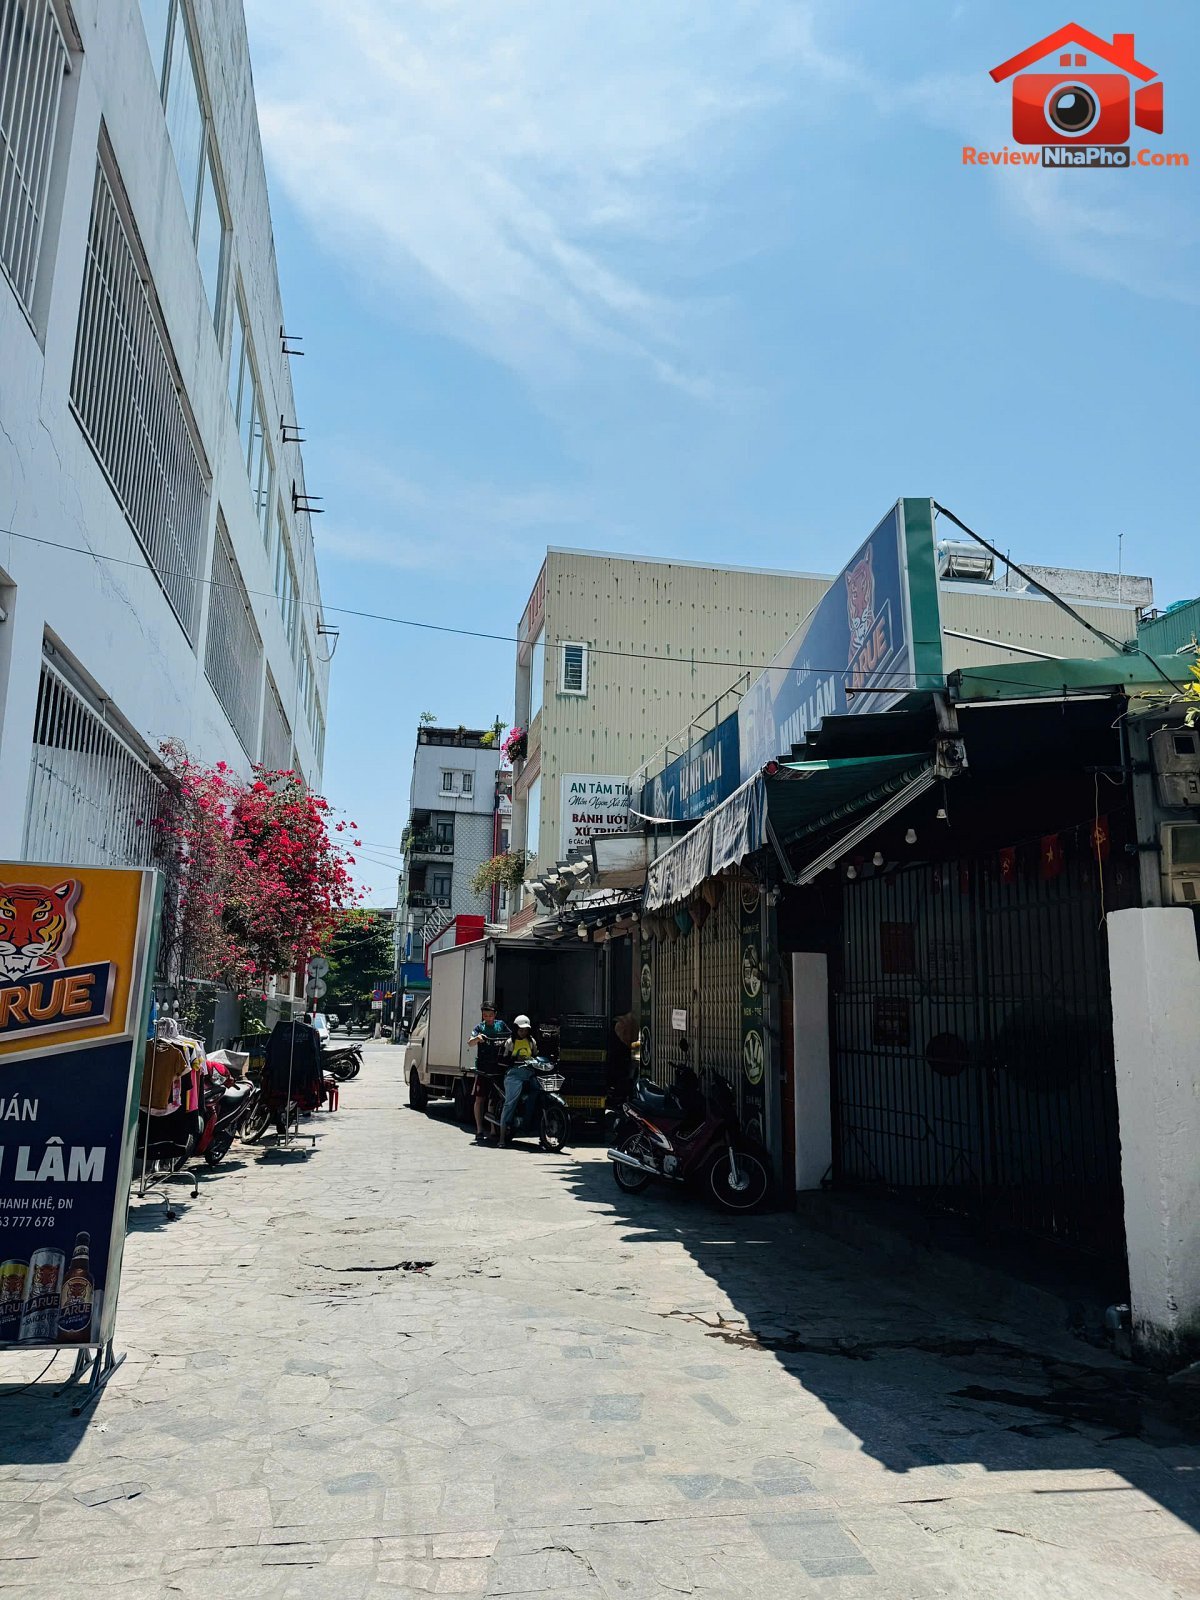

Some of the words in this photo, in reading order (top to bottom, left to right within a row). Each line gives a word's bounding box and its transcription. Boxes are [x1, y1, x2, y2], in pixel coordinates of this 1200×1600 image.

[780, 701, 808, 755] MINH
[809, 675, 836, 730] LÂM
[570, 782, 586, 794] AN
[572, 811, 603, 824] BÁNH
[575, 825, 592, 836] XỨ
[15, 1136, 106, 1182] LÂM
[58, 1198, 74, 1209] ĐN
[12, 1217, 32, 1227] 777
[34, 1217, 55, 1227] 678
[24, 1295, 60, 1313] LARUE
